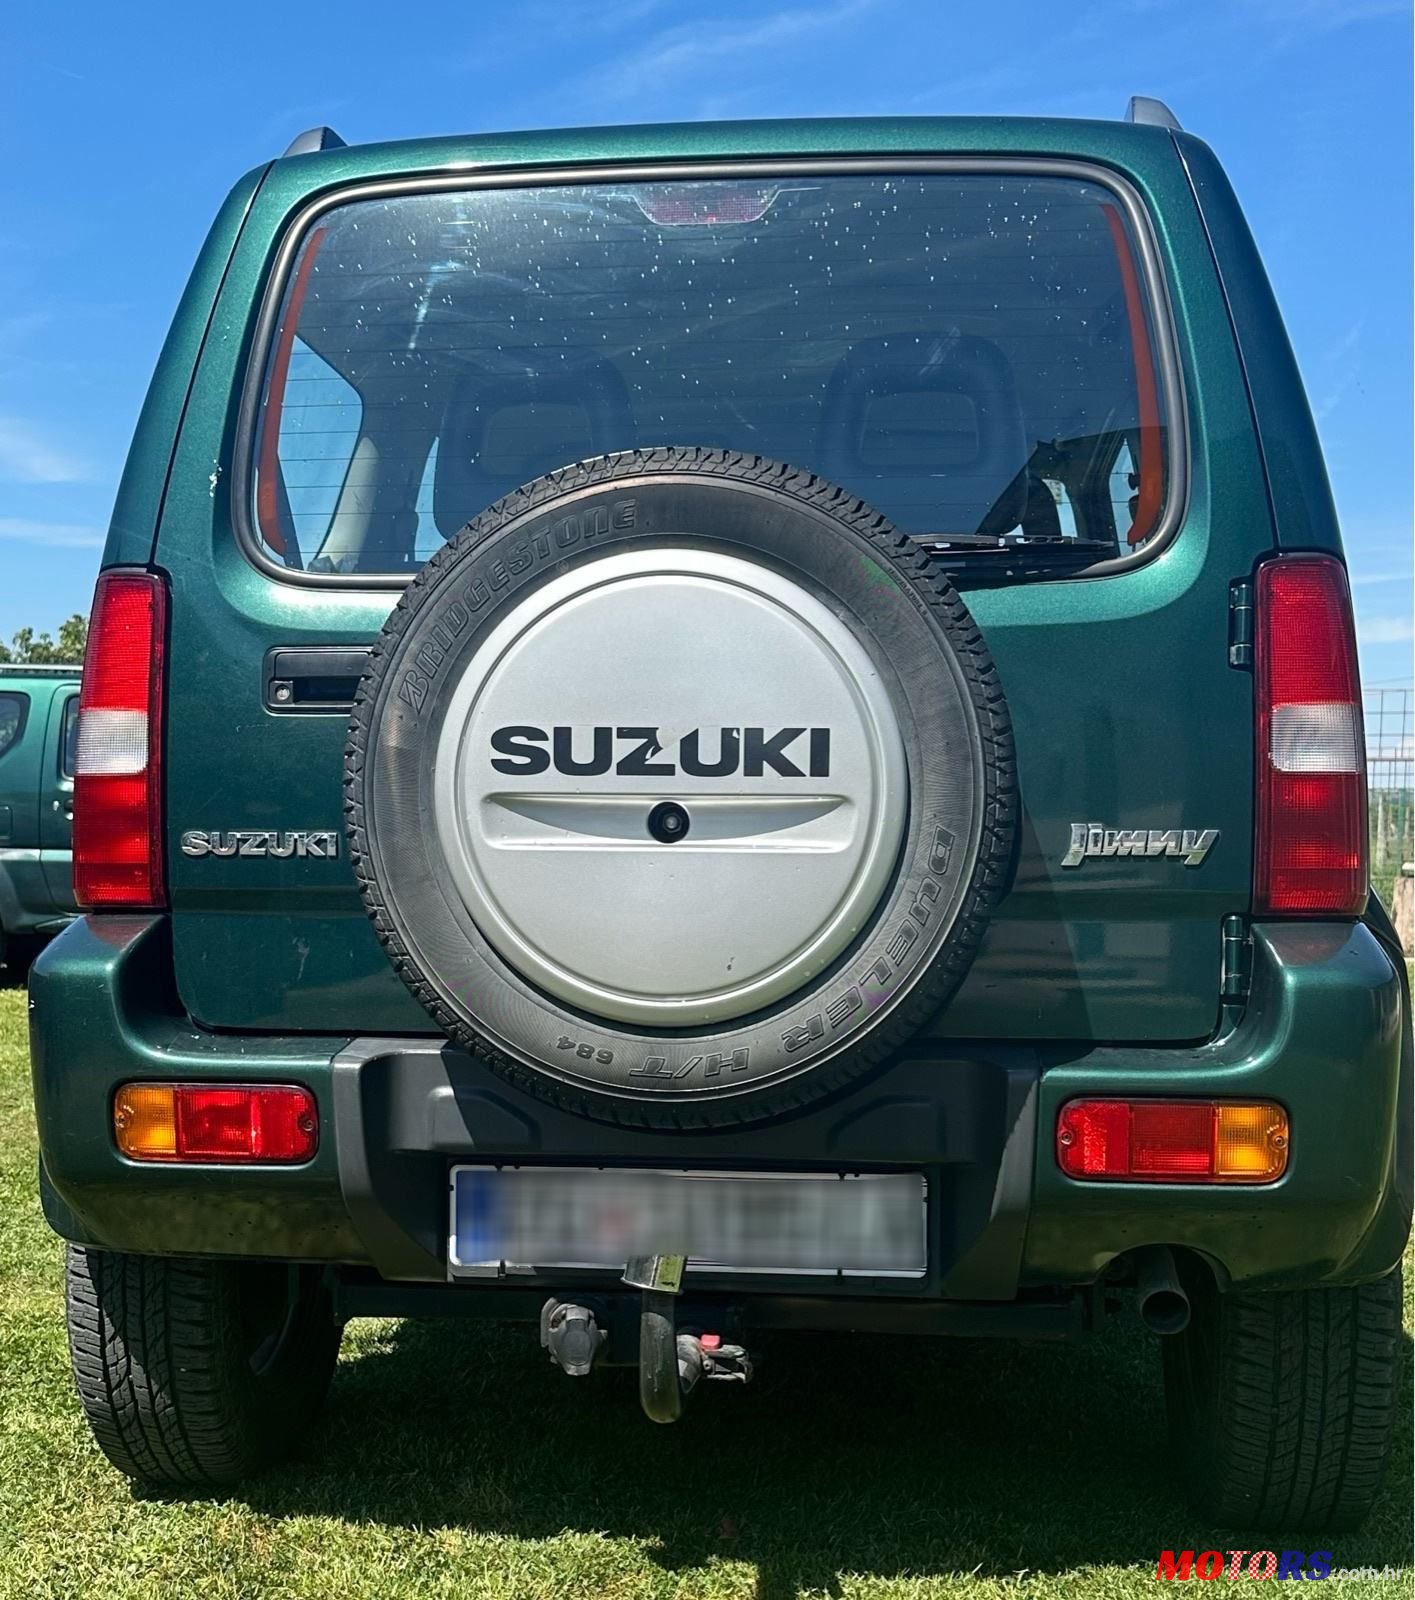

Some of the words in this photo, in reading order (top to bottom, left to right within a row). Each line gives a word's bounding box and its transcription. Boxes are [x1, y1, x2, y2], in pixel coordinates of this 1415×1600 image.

[400, 499, 636, 715] BRIDGESTONE
[490, 725, 831, 777] SUZUKI
[181, 830, 338, 857] SUZUKI
[781, 824, 956, 1053] DUELER
[555, 1035, 615, 1065] 684
[629, 1047, 750, 1080] H/T
